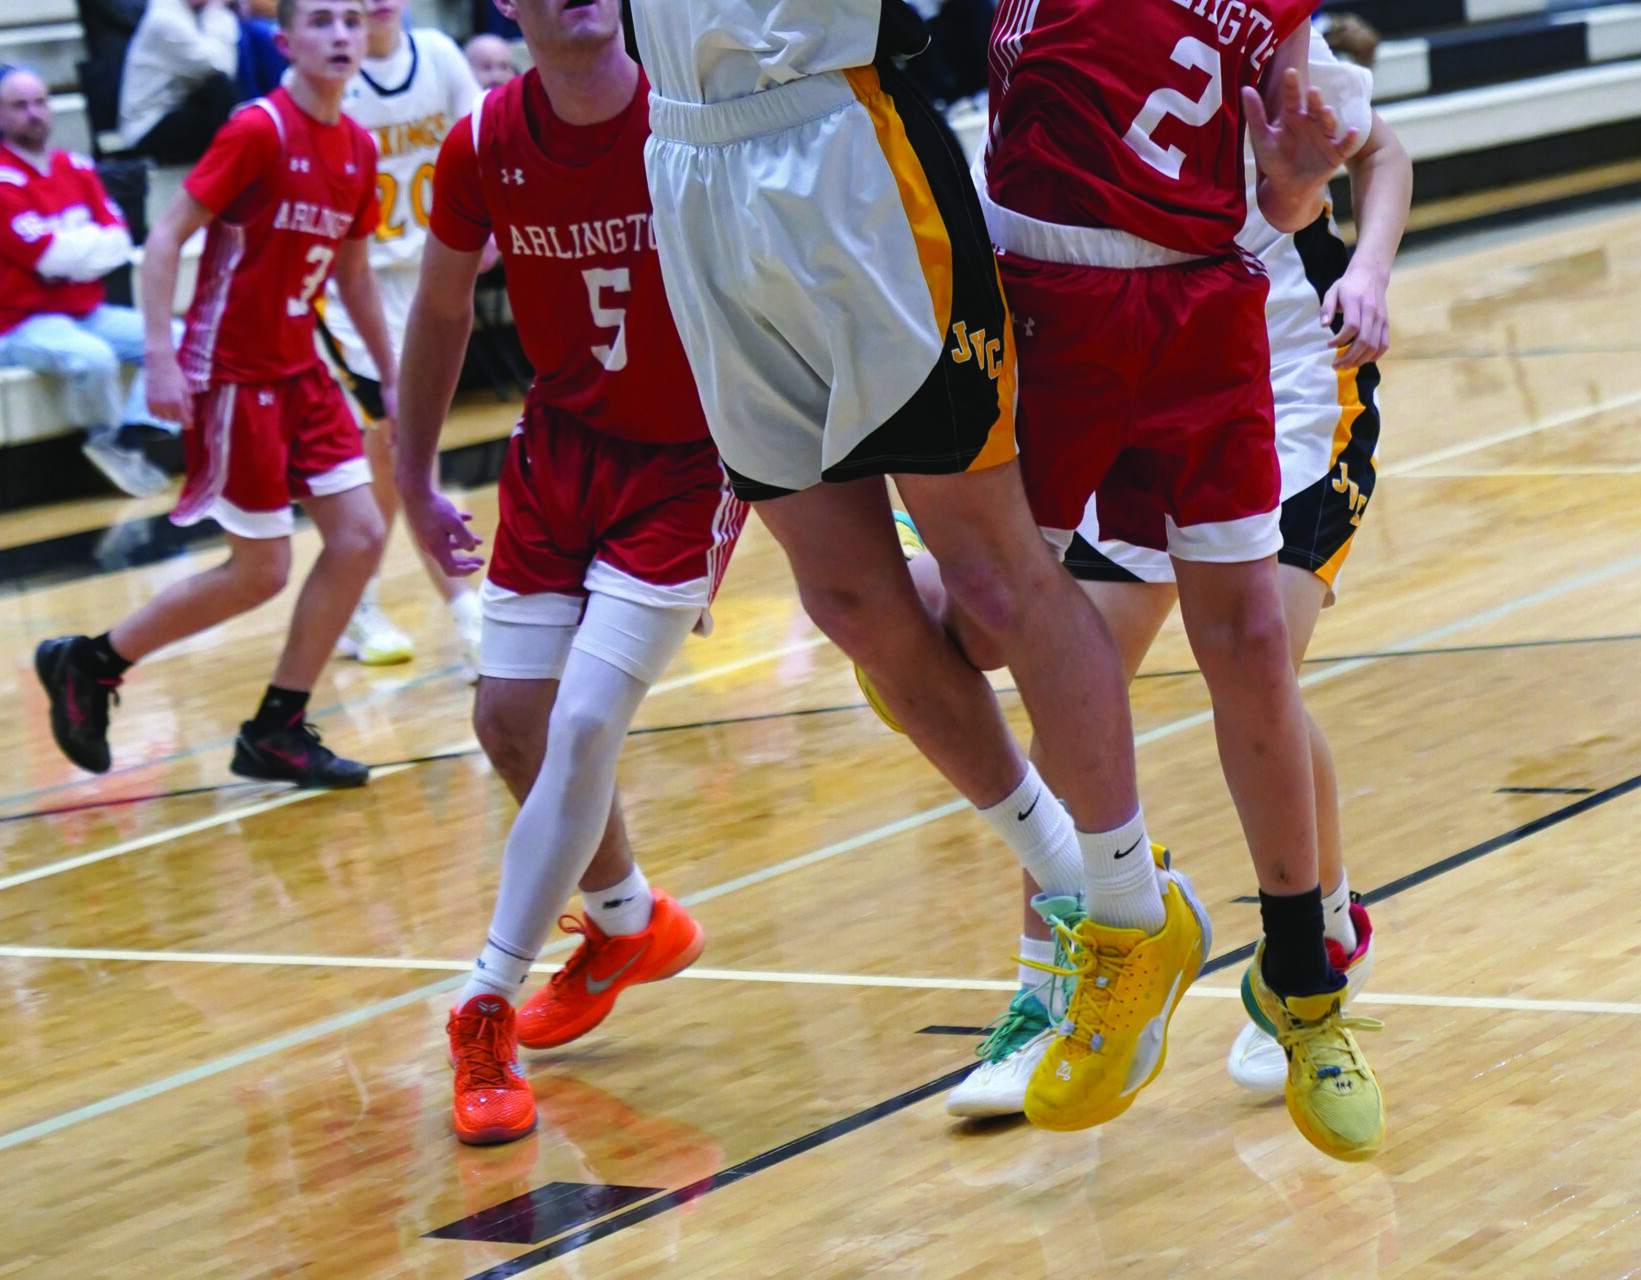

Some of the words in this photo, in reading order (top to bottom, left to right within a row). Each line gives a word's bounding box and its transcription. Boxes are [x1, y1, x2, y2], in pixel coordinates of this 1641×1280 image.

[1121, 35, 1223, 180] 2
[374, 162, 438, 242] 20
[581, 267, 632, 372] 5
[951, 320, 1002, 380] JVC
